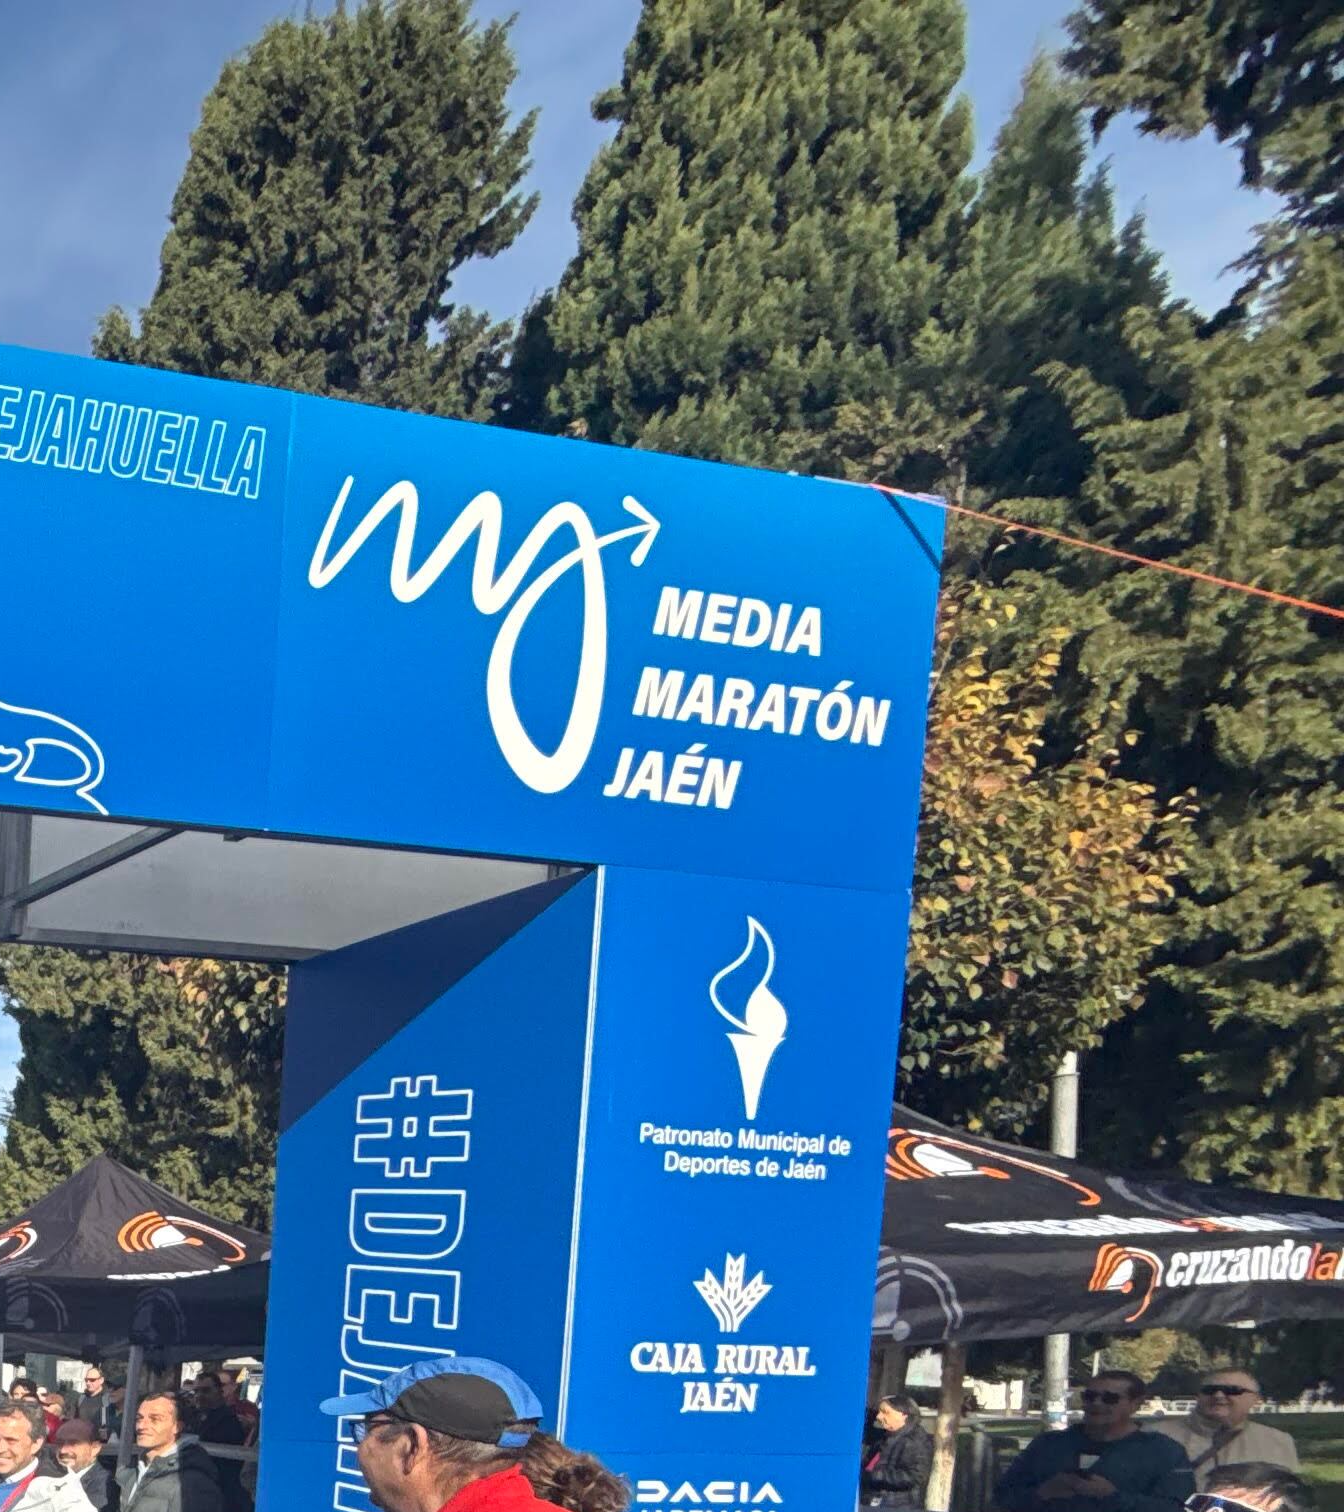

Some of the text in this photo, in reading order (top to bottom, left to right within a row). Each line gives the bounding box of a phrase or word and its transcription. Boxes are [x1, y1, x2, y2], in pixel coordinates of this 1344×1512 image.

[653, 585, 824, 658] MEDIA
[631, 665, 890, 748] MARATÓN
[603, 743, 742, 811] JAÉN
[639, 1121, 851, 1157] Patronato Municipal de
[664, 1151, 827, 1181] Deportes de Jaén
[1166, 1239, 1344, 1288] cruzandola
[630, 1341, 817, 1376] CAJA RURAL
[680, 1377, 759, 1414] JAÉN
[636, 1479, 783, 1504] DACIA
